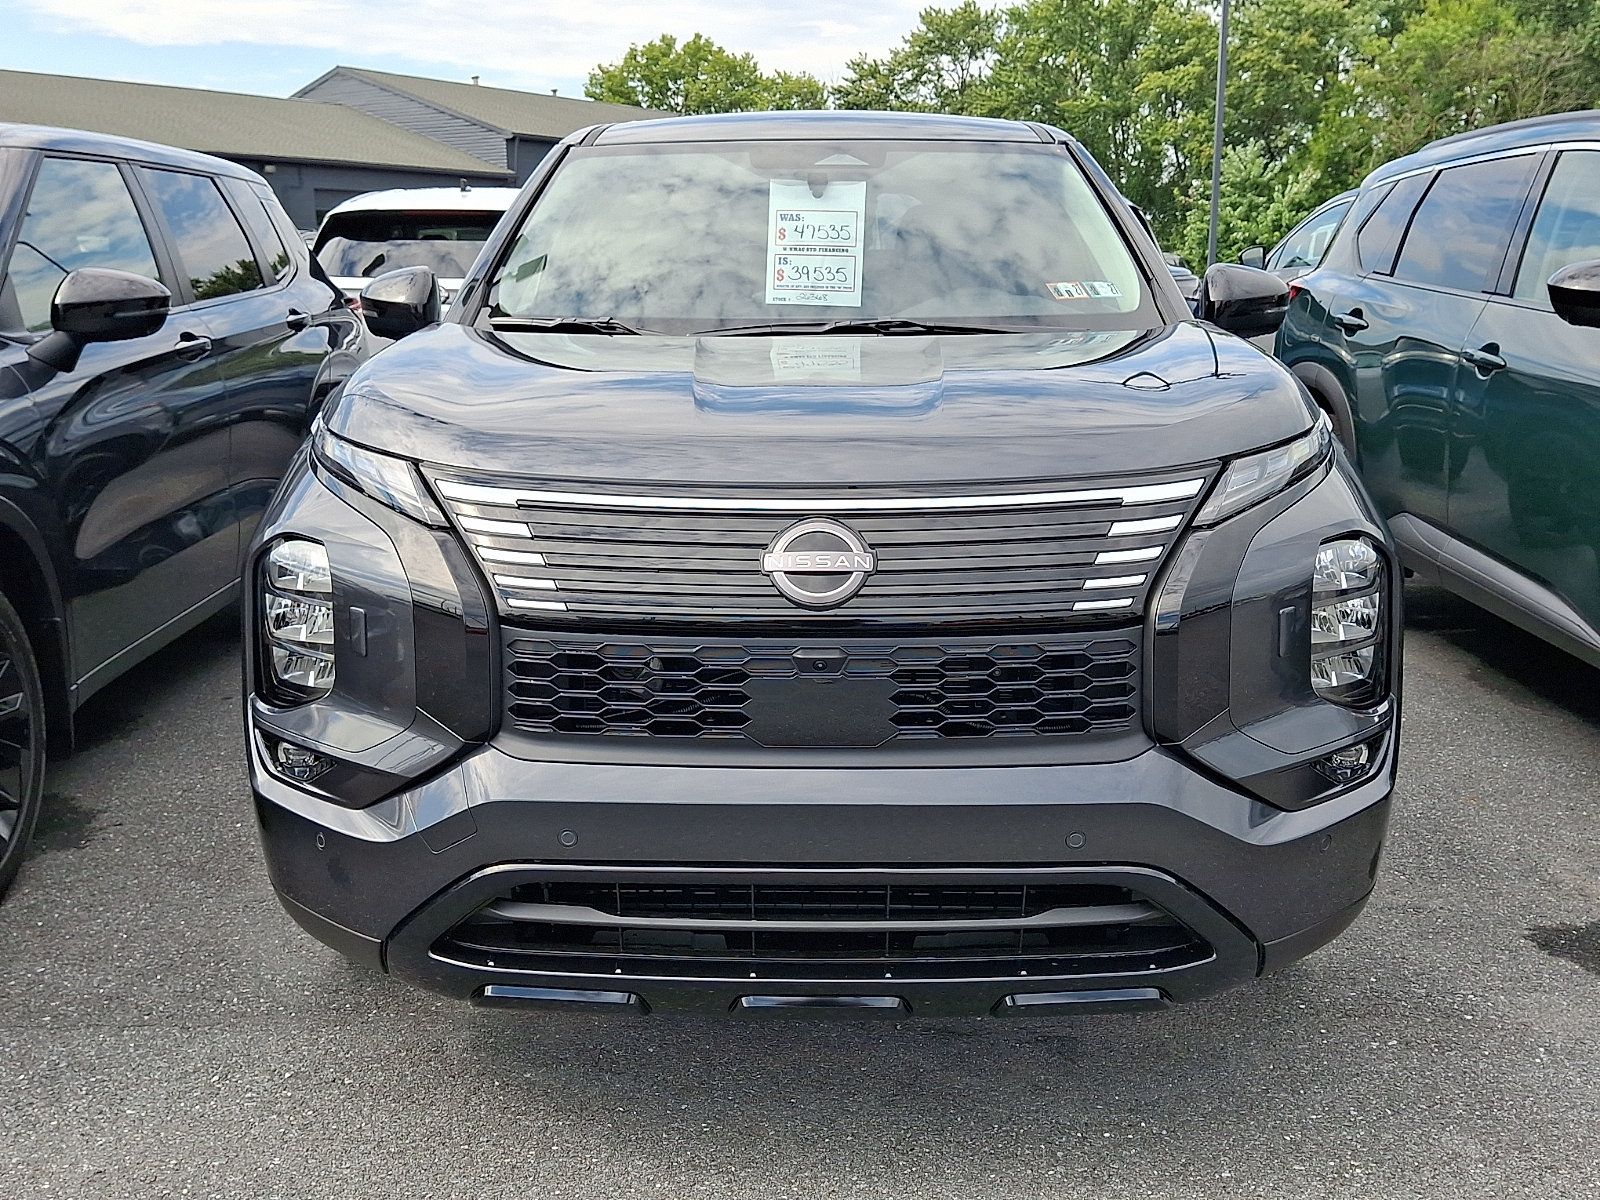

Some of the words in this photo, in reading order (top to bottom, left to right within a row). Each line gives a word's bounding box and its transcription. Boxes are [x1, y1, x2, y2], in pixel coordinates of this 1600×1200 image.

[779, 213, 805, 222] WAS:
[778, 227, 787, 240] $
[793, 223, 851, 241] 47535
[778, 257, 792, 266] IS:
[776, 268, 785, 282] $
[787, 265, 848, 283] 39535
[767, 554, 870, 568] NISSAN
